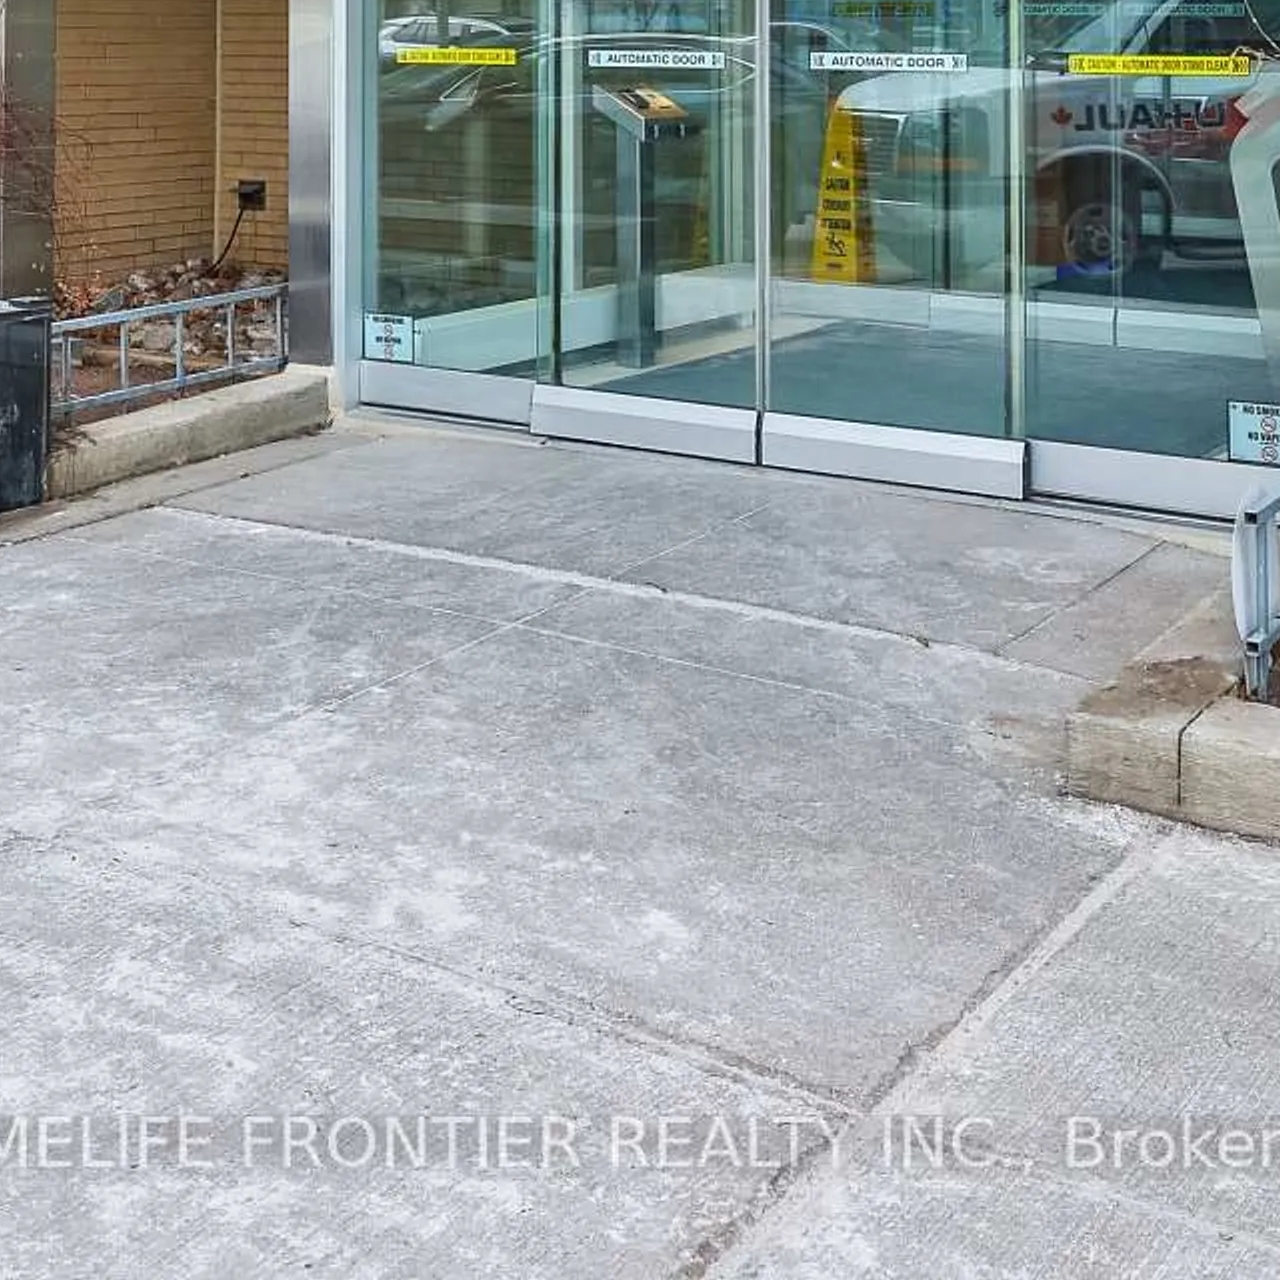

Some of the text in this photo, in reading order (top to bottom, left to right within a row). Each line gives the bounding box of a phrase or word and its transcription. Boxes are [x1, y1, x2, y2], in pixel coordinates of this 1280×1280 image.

[608, 53, 706, 65] AUTOMATIC DOOR
[831, 56, 945, 68] AUTOMATIC DOOR
[1243, 405, 1255, 415] NO
[1248, 432, 1259, 441] NO
